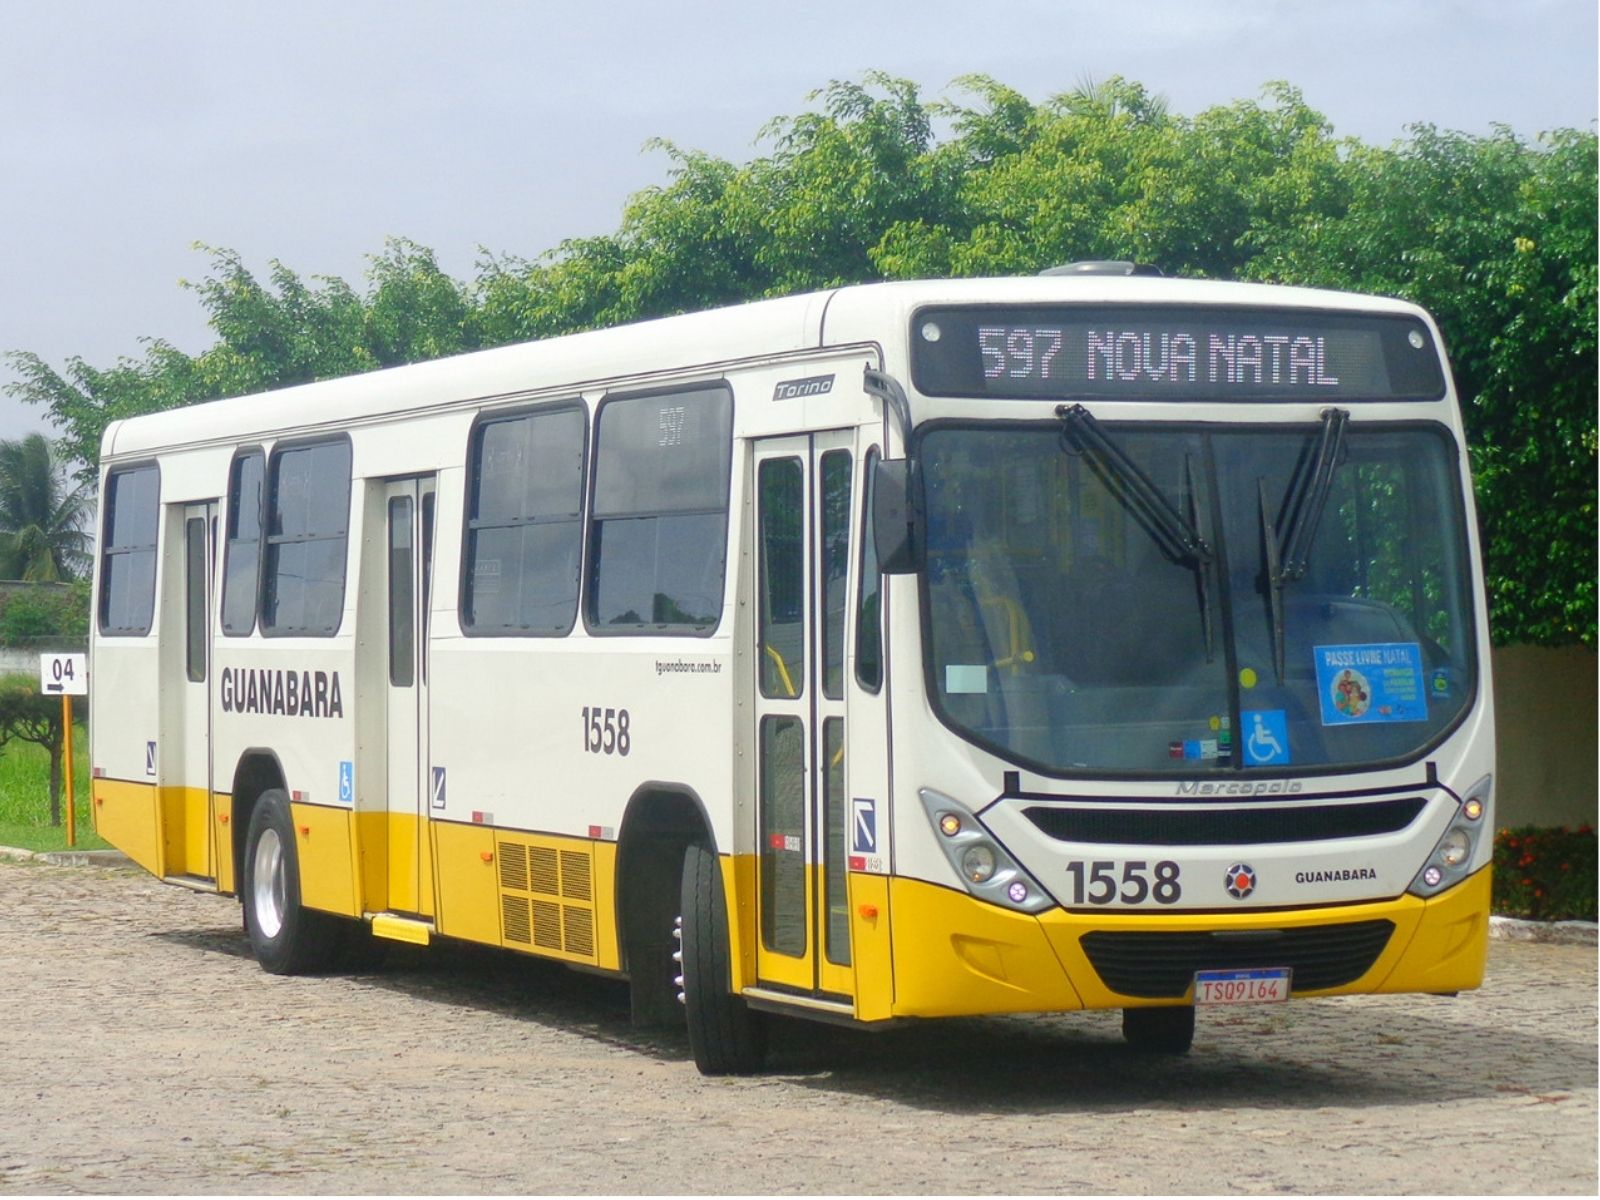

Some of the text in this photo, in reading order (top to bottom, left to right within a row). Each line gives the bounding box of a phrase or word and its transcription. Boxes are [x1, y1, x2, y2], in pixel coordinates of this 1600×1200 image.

[979, 328, 1340, 386] 597 NOVA NATAL
[777, 380, 831, 399] Torino
[655, 658, 722, 676] tguanabara.com.br
[1325, 648, 1413, 667] PASSE LIVRE NATAL
[52, 658, 74, 681] 04
[221, 666, 343, 719] GUANABARA
[582, 706, 631, 757] 1558
[1175, 780, 1303, 796] Marcopolo
[1065, 860, 1182, 905] 1558
[1295, 868, 1377, 884] GUANABARA
